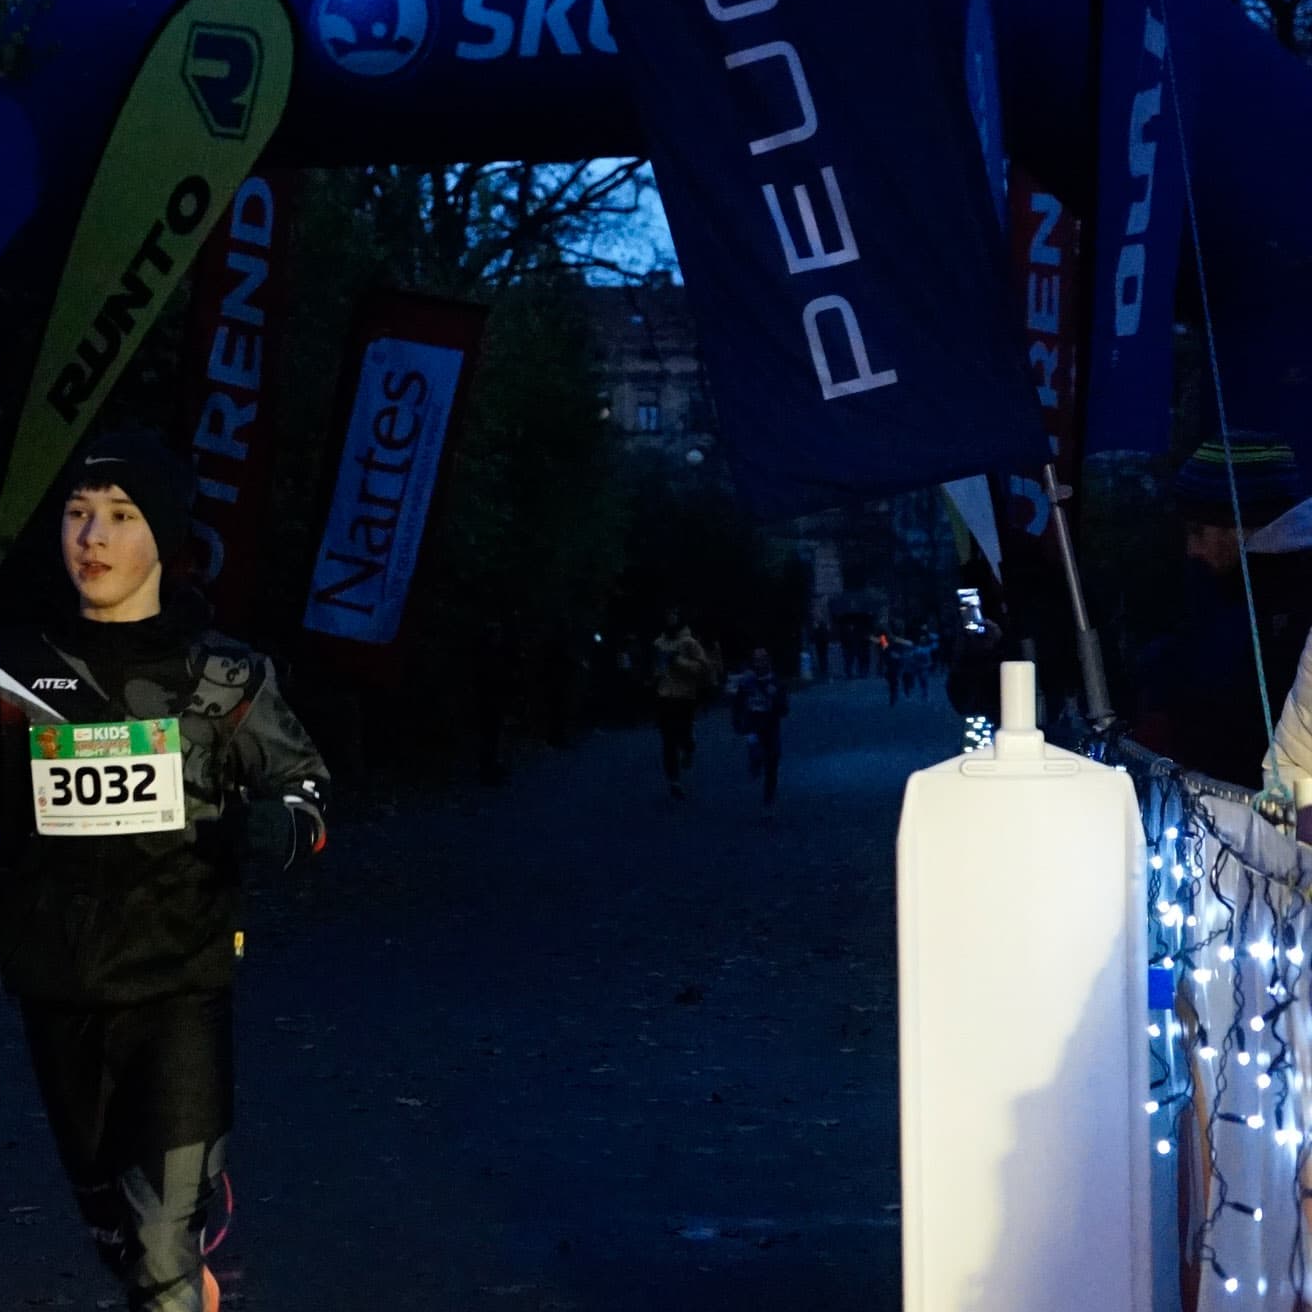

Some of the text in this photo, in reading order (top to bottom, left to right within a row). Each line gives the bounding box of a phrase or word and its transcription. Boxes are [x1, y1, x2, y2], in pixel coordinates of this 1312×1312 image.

[45, 174, 211, 427] RUNTO
[314, 370, 428, 615] Nartes
[32, 677, 79, 691] ATEX
[93, 725, 131, 740] KIDS
[49, 763, 157, 806] 3032
